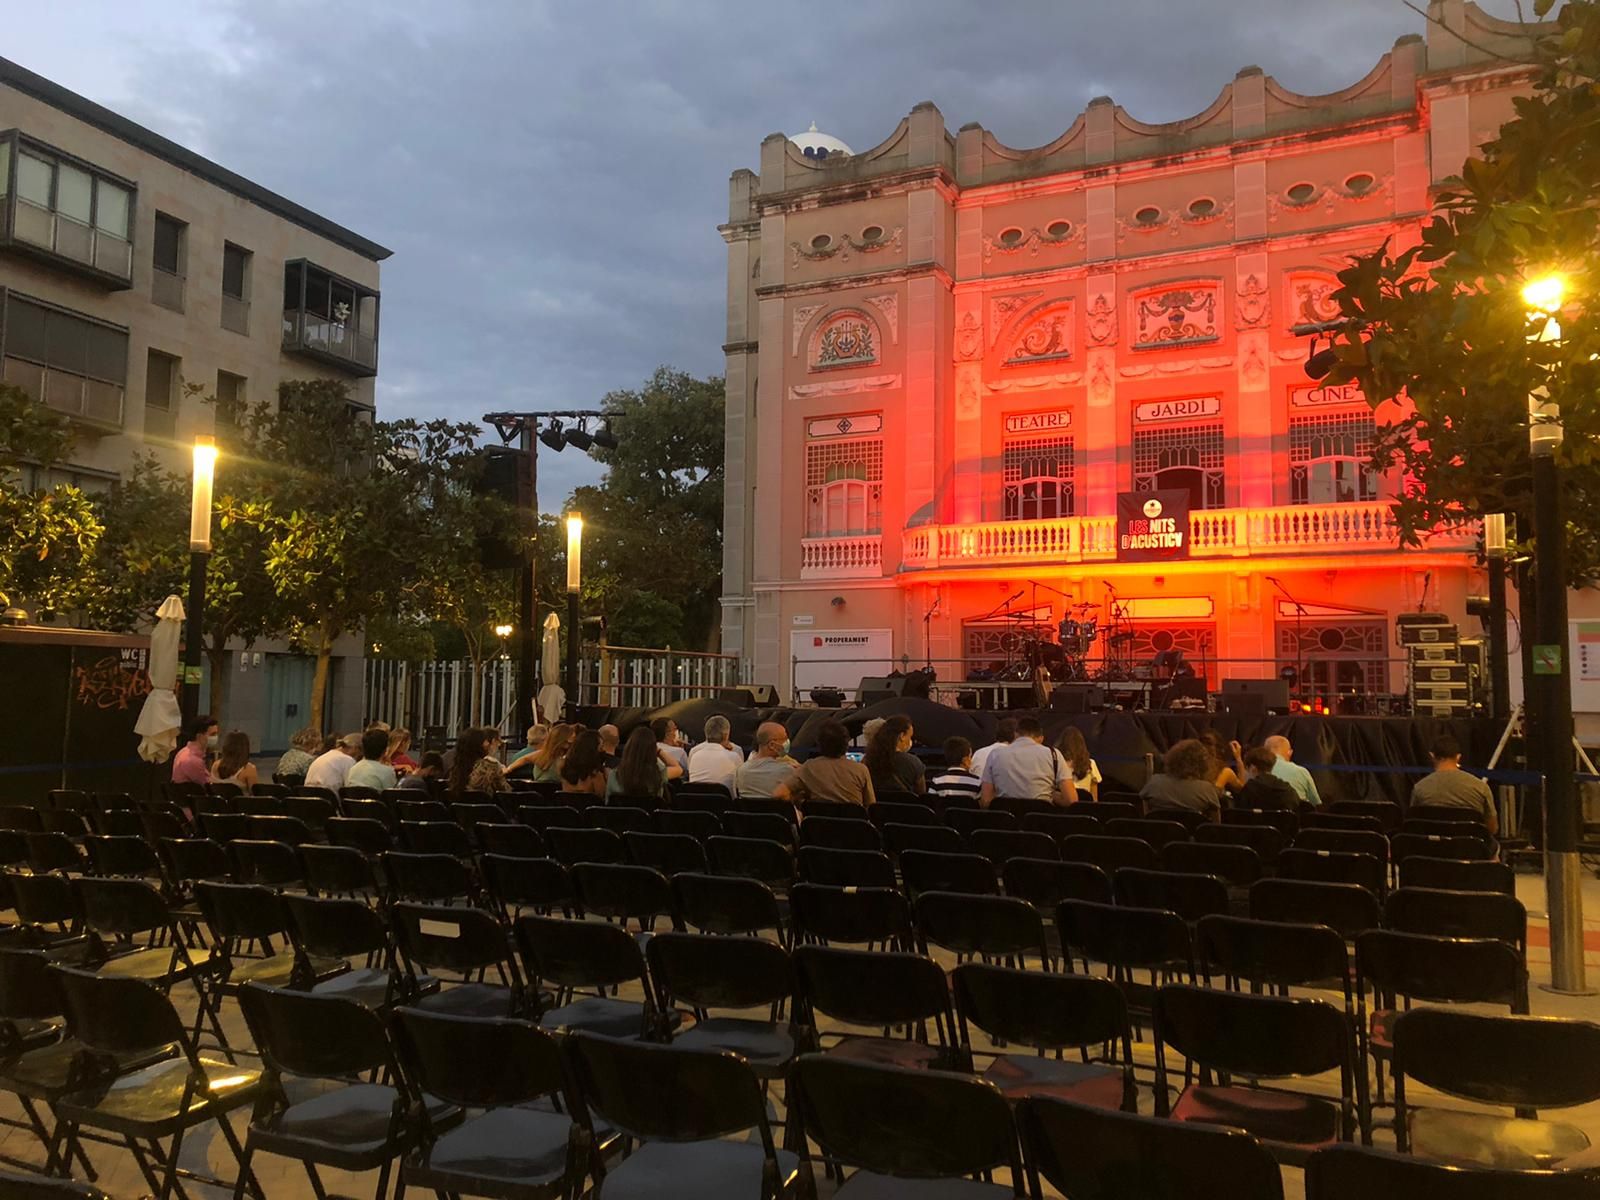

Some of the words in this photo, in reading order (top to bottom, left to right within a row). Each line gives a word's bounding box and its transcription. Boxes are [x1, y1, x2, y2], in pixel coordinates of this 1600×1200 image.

[1307, 385, 1355, 402] CINE
[1151, 399, 1205, 417] JARDI
[1010, 413, 1067, 429] TEATRE
[1129, 519, 1148, 535] LES
[1149, 518, 1175, 533] NITS
[120, 648, 138, 660] WC
